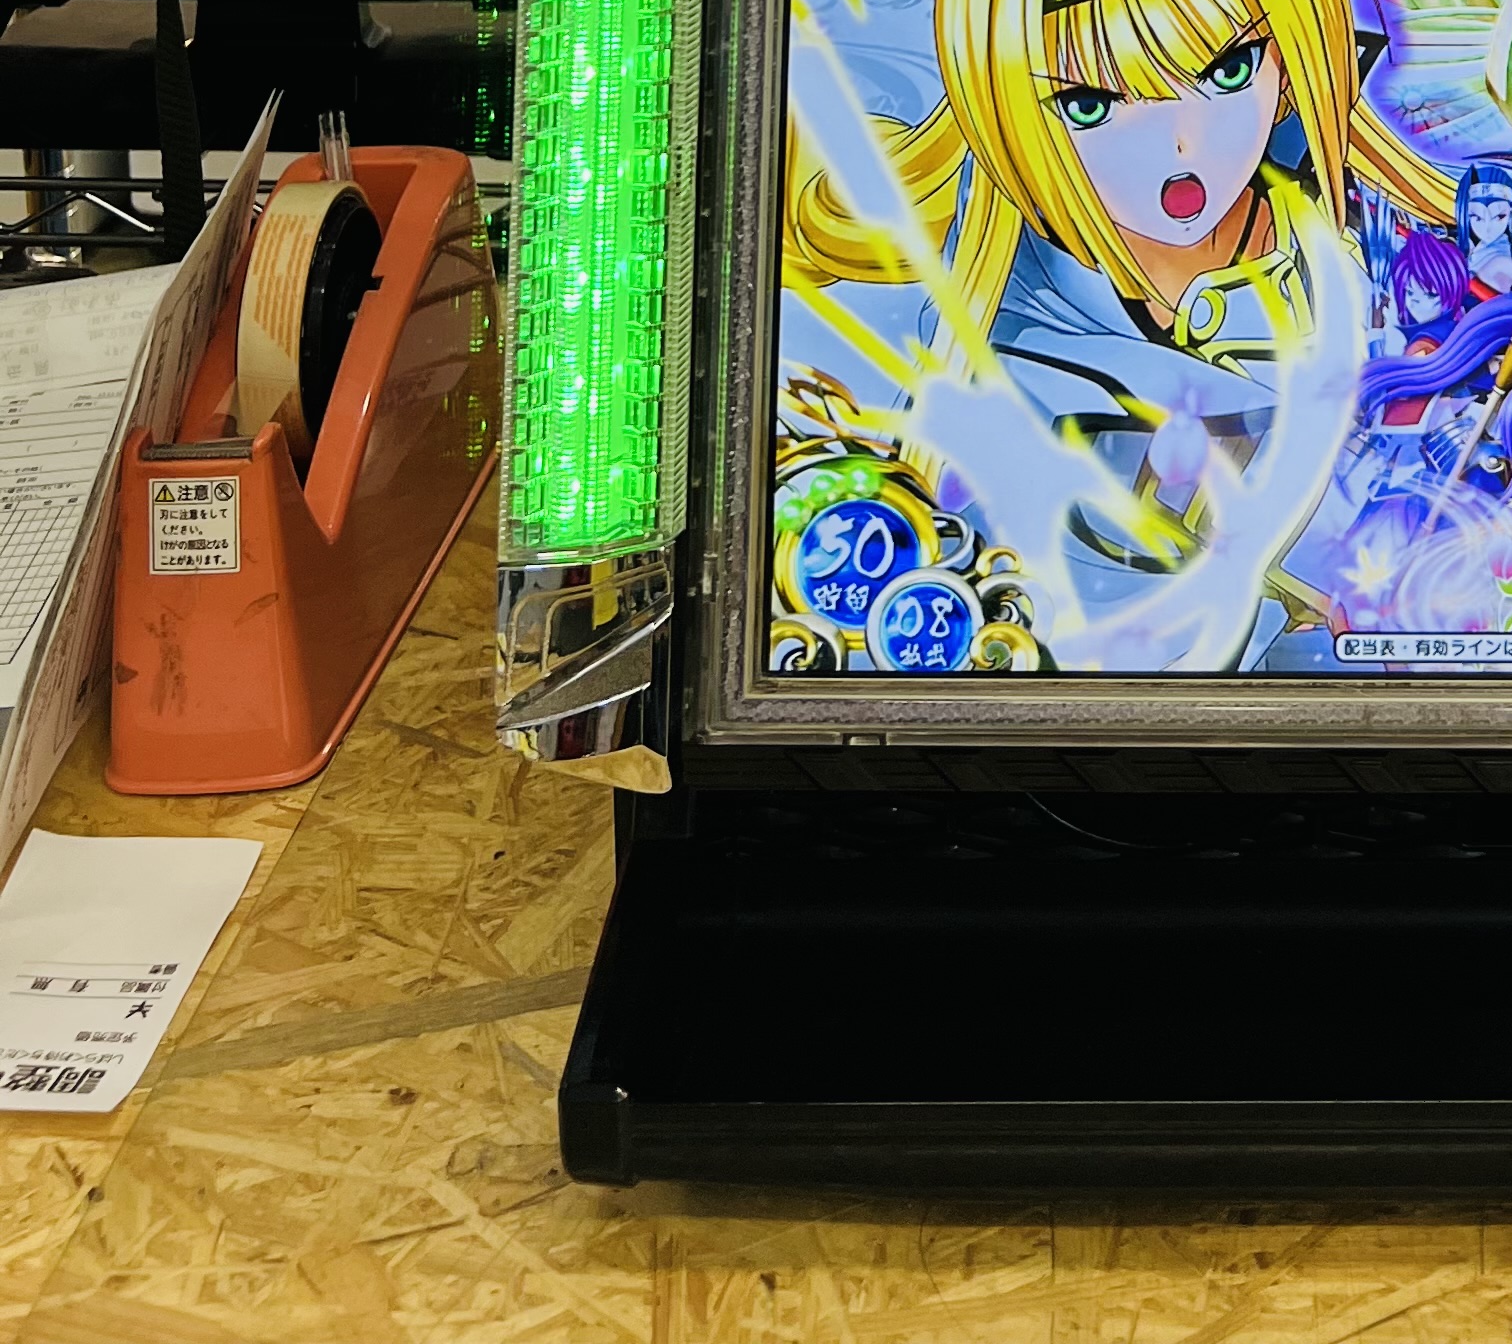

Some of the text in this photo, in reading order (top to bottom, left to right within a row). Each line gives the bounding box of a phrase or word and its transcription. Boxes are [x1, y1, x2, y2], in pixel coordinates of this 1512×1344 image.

[177, 483, 210, 502] 注意
[804, 512, 896, 579] 50
[889, 593, 956, 638] 08
[0, 1064, 108, 1096] 調整
